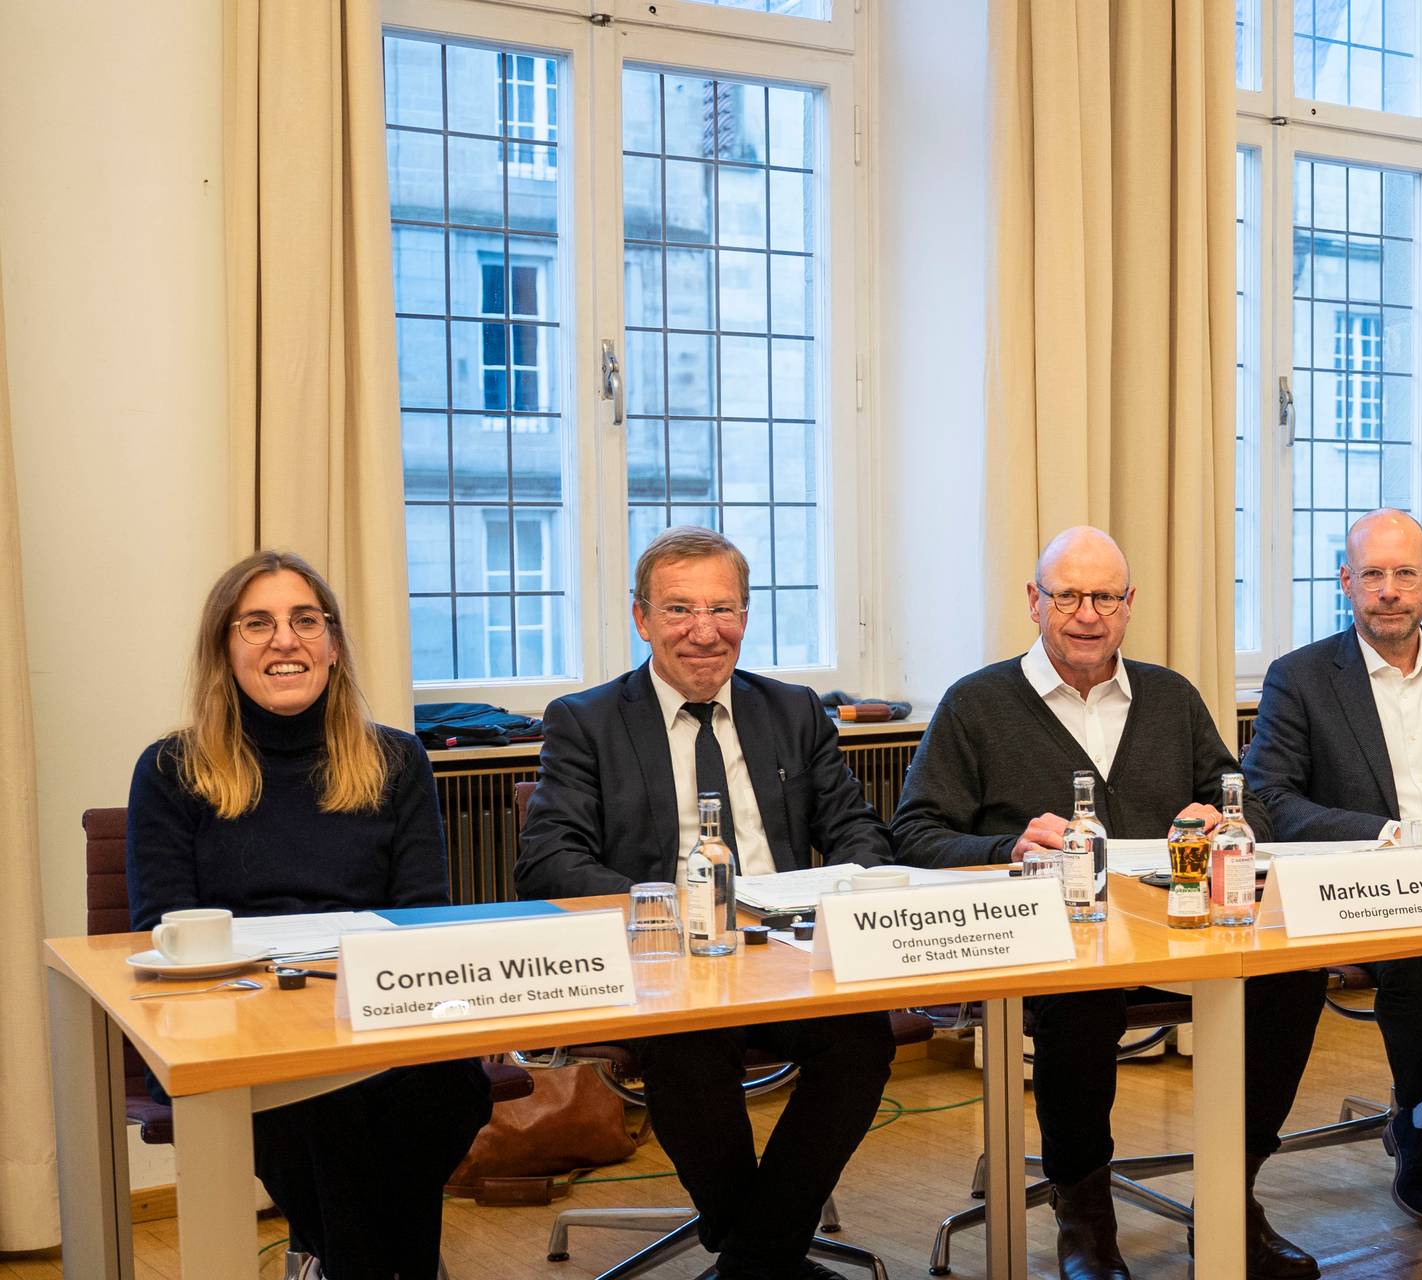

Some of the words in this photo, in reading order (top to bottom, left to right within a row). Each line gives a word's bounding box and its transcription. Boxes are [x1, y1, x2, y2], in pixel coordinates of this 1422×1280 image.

[1319, 881, 1391, 901] Markus
[854, 908, 967, 931] Wolfgang
[973, 901, 1039, 921] Heuer
[892, 929, 1015, 950] Ordnungsdezernent
[901, 953, 922, 964] der
[925, 950, 959, 962] Stadt
[961, 945, 1011, 958] Münster
[376, 963, 492, 991] Cornelia
[499, 956, 605, 980] Wilkens
[362, 995, 495, 1017] Sozialdezntin
[499, 992, 522, 1004] der
[527, 988, 565, 1001] Stadt
[568, 984, 625, 998] Münster
